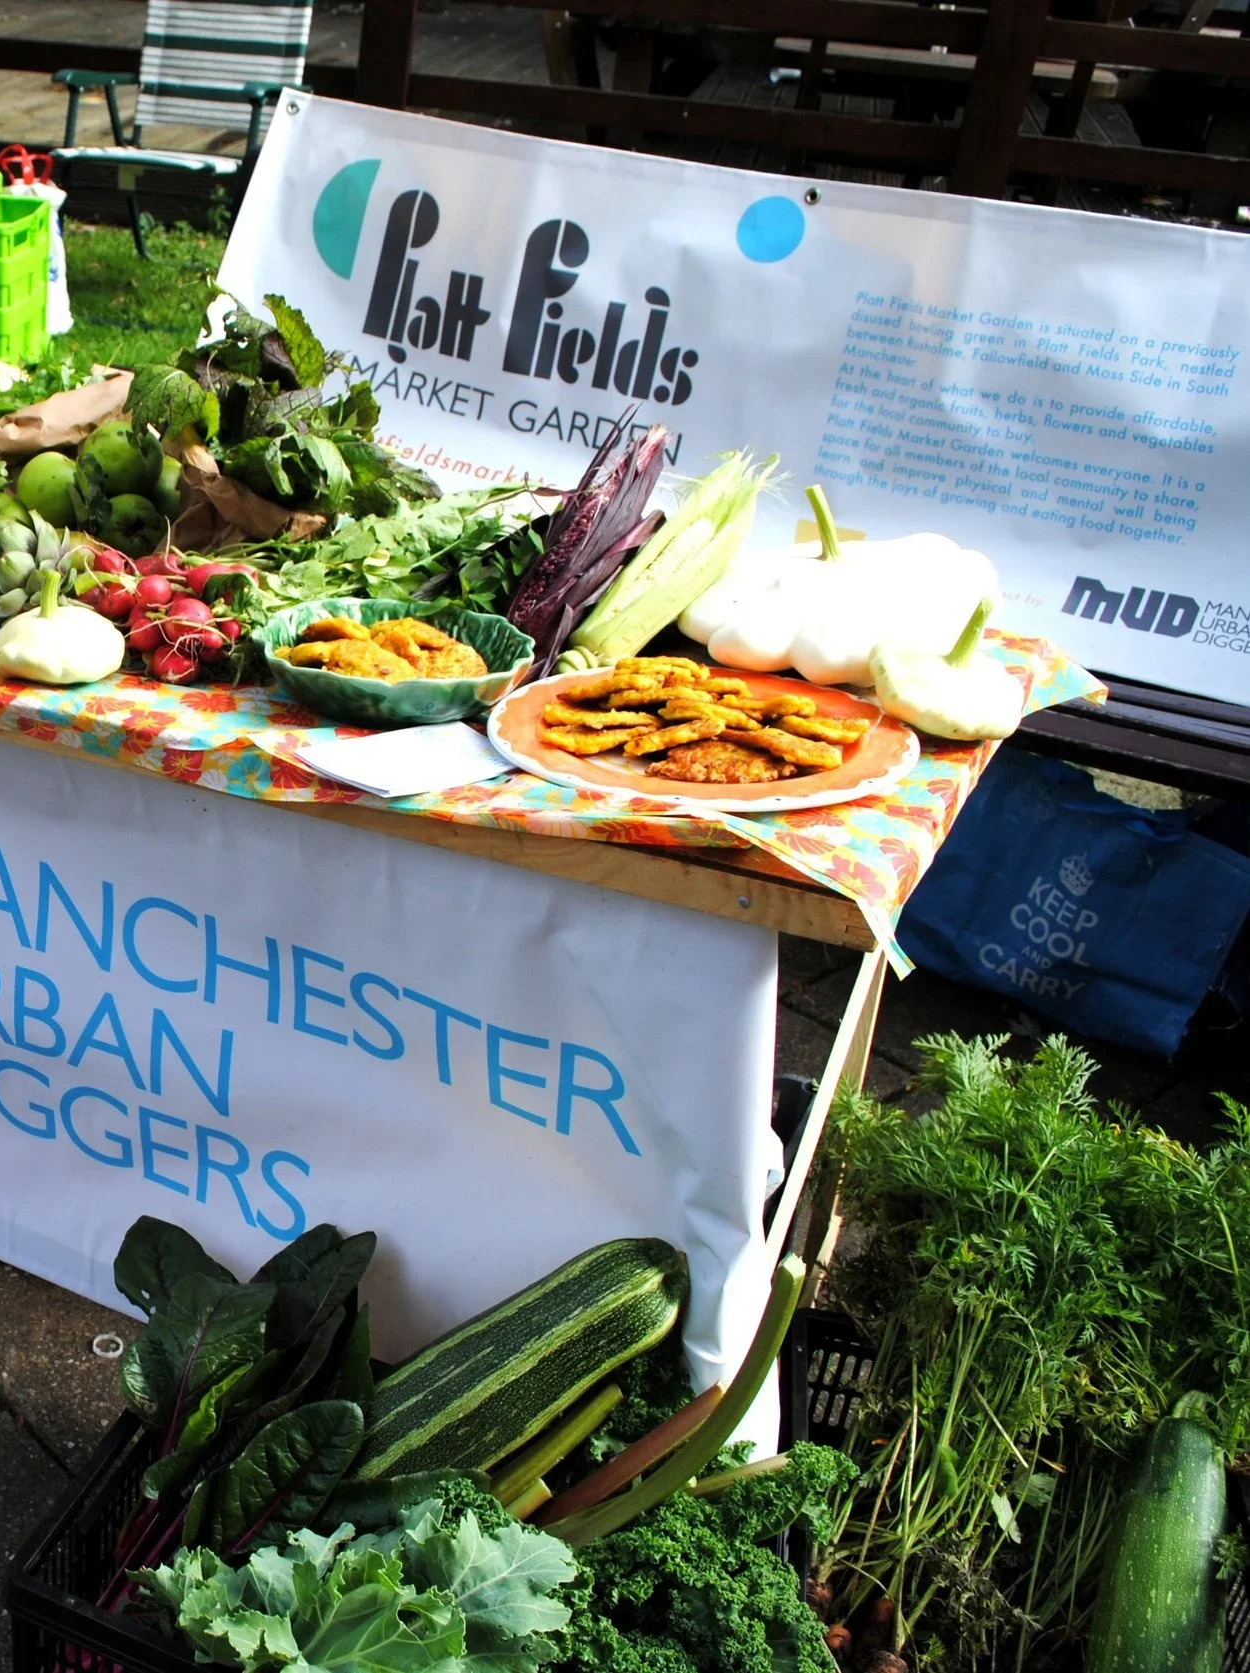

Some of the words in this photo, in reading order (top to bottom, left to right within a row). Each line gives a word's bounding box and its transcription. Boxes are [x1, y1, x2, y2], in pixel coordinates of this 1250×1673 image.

[362, 189, 491, 363] Platt
[503, 218, 699, 405] Fields
[856, 290, 885, 306] Platt
[890, 296, 923, 314] Fields
[927, 305, 973, 323] Market
[980, 312, 1033, 330] Garden
[1040, 324, 1050, 333] is
[1056, 324, 1114, 341] situated
[1120, 335, 1138, 345] on
[1145, 339, 1155, 348] a
[1160, 341, 1240, 362] previously
[847, 325, 903, 346] between
[907, 337, 965, 360] Rusholme,
[972, 348, 1048, 370] Fallowfield
[1053, 362, 1081, 375] and
[1086, 364, 1124, 381] Moss
[1130, 370, 1162, 387] Side
[1167, 376, 1180, 390] in
[1186, 380, 1229, 396] South
[850, 309, 902, 328] disused
[909, 319, 954, 342] bowling
[964, 332, 1004, 345] green
[1014, 336, 1026, 348] in
[1037, 338, 1068, 353] Platt
[1078, 343, 1120, 361] Fields
[1131, 351, 1168, 371] Park,
[1180, 362, 1235, 378] nestled
[345, 354, 495, 421] MARKET
[832, 394, 849, 408] for
[855, 400, 874, 414] the
[879, 404, 906, 420] local
[909, 415, 981, 437] community
[986, 426, 1000, 437] to
[1006, 426, 1034, 445] buy.
[836, 377, 866, 394] fresh
[872, 389, 896, 400] and
[899, 394, 945, 411] organic
[950, 401, 988, 418] fruits,
[995, 407, 1037, 426] herbs,
[1044, 413, 1093, 434] flowers
[1099, 427, 1127, 439] and
[1133, 433, 1214, 454] vegetables
[838, 362, 854, 374] At
[860, 366, 881, 380] the
[888, 370, 915, 387] heart
[920, 378, 934, 391] of
[939, 383, 974, 396] what
[980, 391, 1000, 401] we
[1007, 390, 1026, 404] do
[1033, 394, 1044, 408] is
[1050, 399, 1064, 411] to
[1070, 404, 1125, 421] provide
[1132, 411, 1216, 437] affordable,
[822, 432, 860, 448] space
[865, 438, 881, 452] for
[885, 445, 900, 457] all
[905, 450, 965, 469] members
[970, 460, 985, 472] of
[988, 462, 1010, 477] the
[1015, 465, 1050, 483] local
[1054, 476, 1128, 501] community
[1134, 489, 1148, 501] to
[1154, 490, 1200, 511] share,
[828, 413, 855, 428] Platt
[859, 419, 892, 437] Fields
[897, 430, 946, 447] Market
[950, 439, 1004, 458] Garden
[1010, 450, 1078, 470] welcomes
[1084, 463, 1154, 484] everyone.
[1162, 473, 1173, 486] It
[1177, 476, 1189, 490] is
[1195, 482, 1205, 492] a
[814, 464, 863, 486] through
[868, 474, 888, 488] the
[892, 480, 918, 497] joys
[923, 485, 938, 498] of
[941, 491, 997, 514] growing
[1001, 503, 1029, 516] and
[1032, 509, 1076, 528] eating
[1080, 514, 1115, 532] food
[1119, 523, 1186, 546] together.
[818, 446, 851, 463] learn
[860, 458, 885, 471] and
[893, 461, 946, 482] improve
[954, 475, 1012, 495] physical
[1021, 488, 1048, 501] and
[1057, 495, 1105, 512] mental
[1114, 505, 1145, 520] well
[1154, 508, 1196, 531] being
[1200, 615, 1250, 639] URBA
[1010, 903, 1092, 968] COOL
[1027, 876, 1099, 933] KEEP
[978, 943, 1087, 1001] CARRY
[1020, 945, 1052, 970] AND
